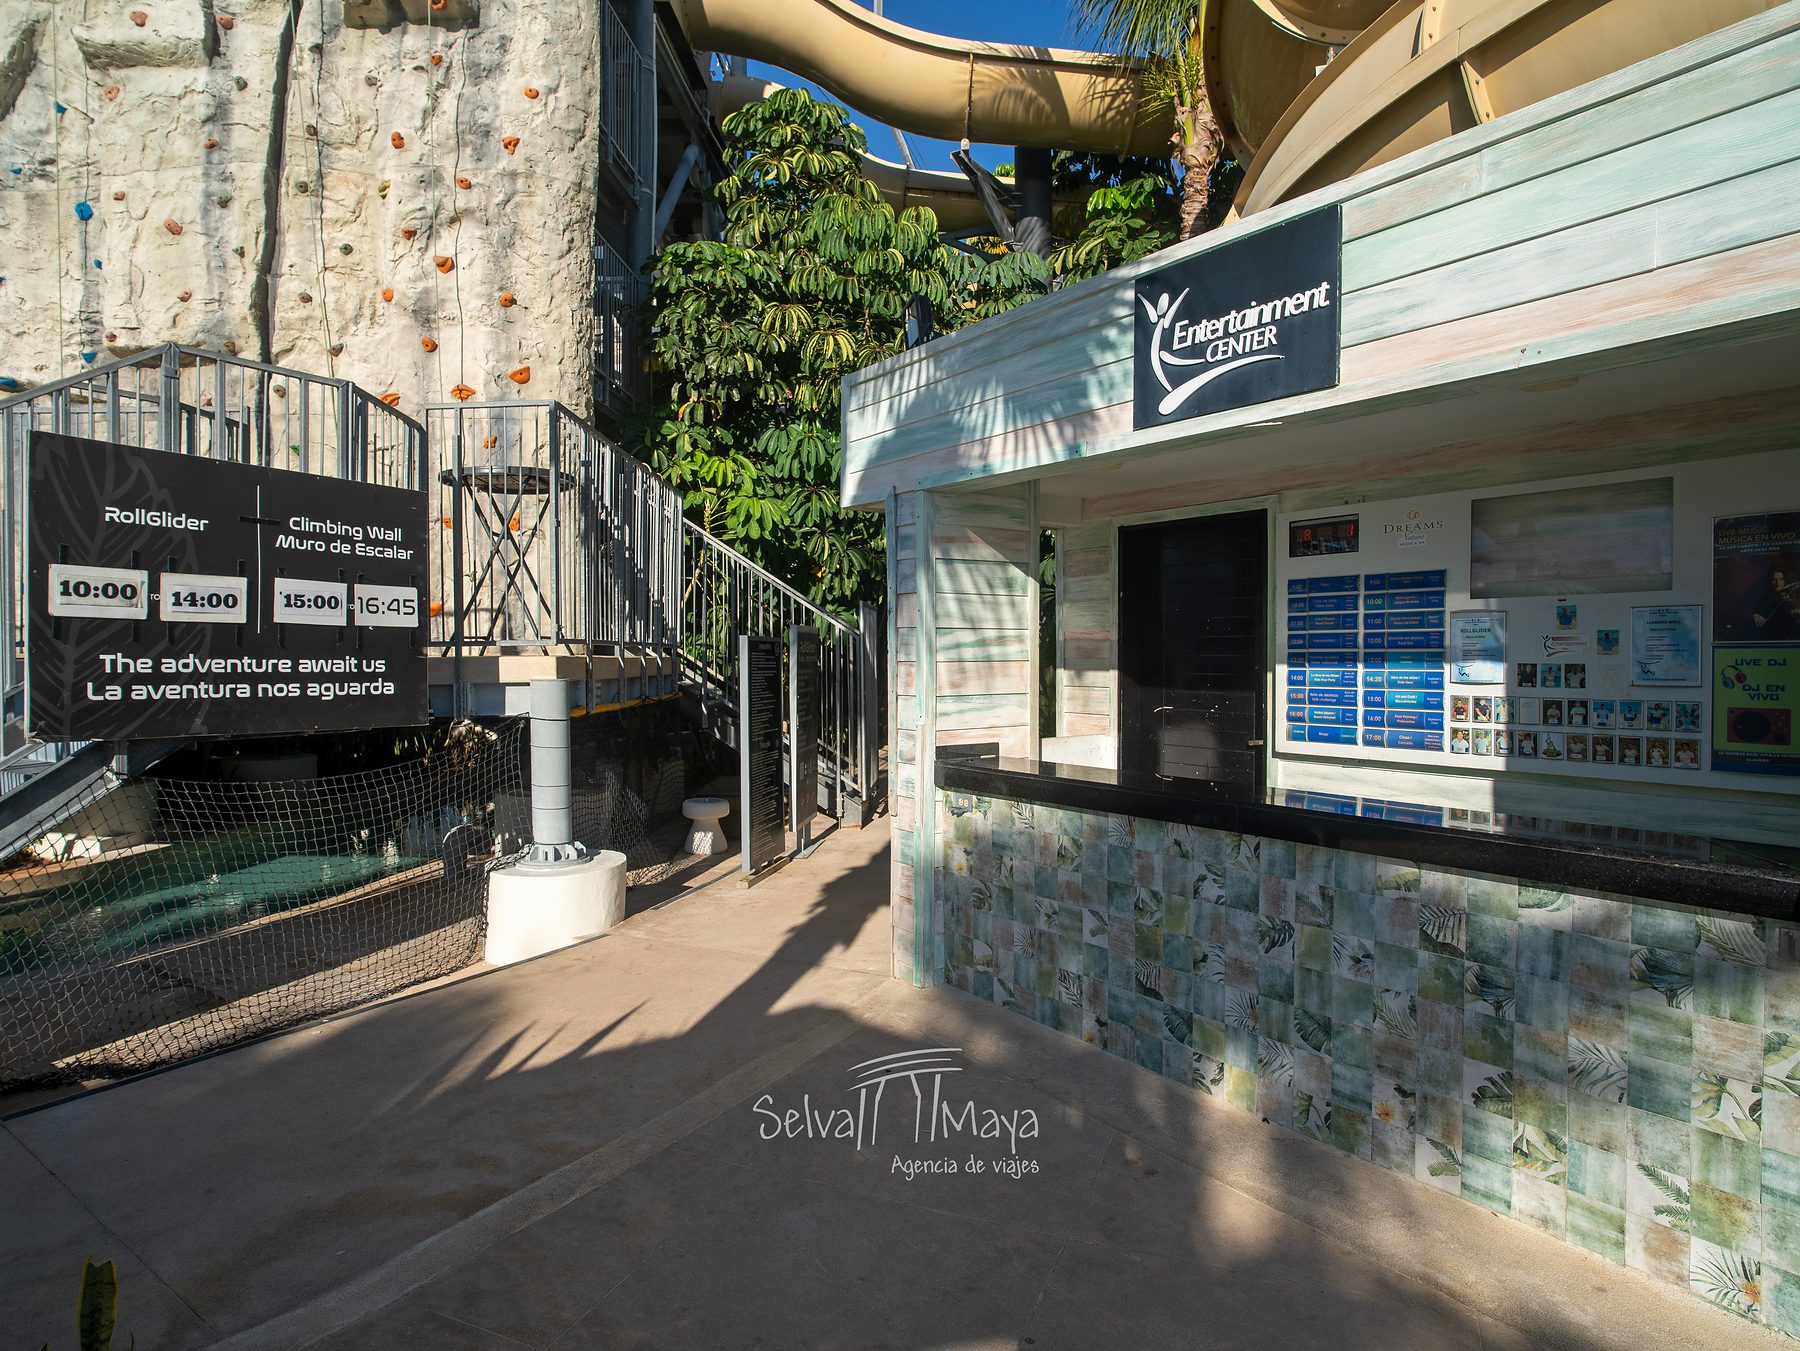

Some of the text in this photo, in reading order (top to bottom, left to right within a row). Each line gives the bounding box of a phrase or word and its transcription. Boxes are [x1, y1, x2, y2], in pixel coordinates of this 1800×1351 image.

[1173, 281, 1330, 350] Entertainment
[1206, 325, 1277, 363] CENTER
[105, 506, 209, 531] RollGlider
[289, 517, 402, 542] Climbing Wall
[1384, 520, 1445, 534] DREAMS
[275, 534, 414, 560] Muro de Escalar
[1755, 534, 1768, 542] EN
[1769, 531, 1796, 540] VIVO
[59, 580, 138, 600] 10:00
[171, 591, 239, 609] 14:00
[284, 593, 340, 610] 15:00
[357, 596, 416, 615] 16:45
[101, 653, 387, 673] The adventure await us
[1735, 658, 1787, 666] LIVE DJ
[87, 677, 396, 701] La aventura nos aguarda
[1748, 692, 1780, 701] VIVO
[1766, 684, 1785, 692] EN
